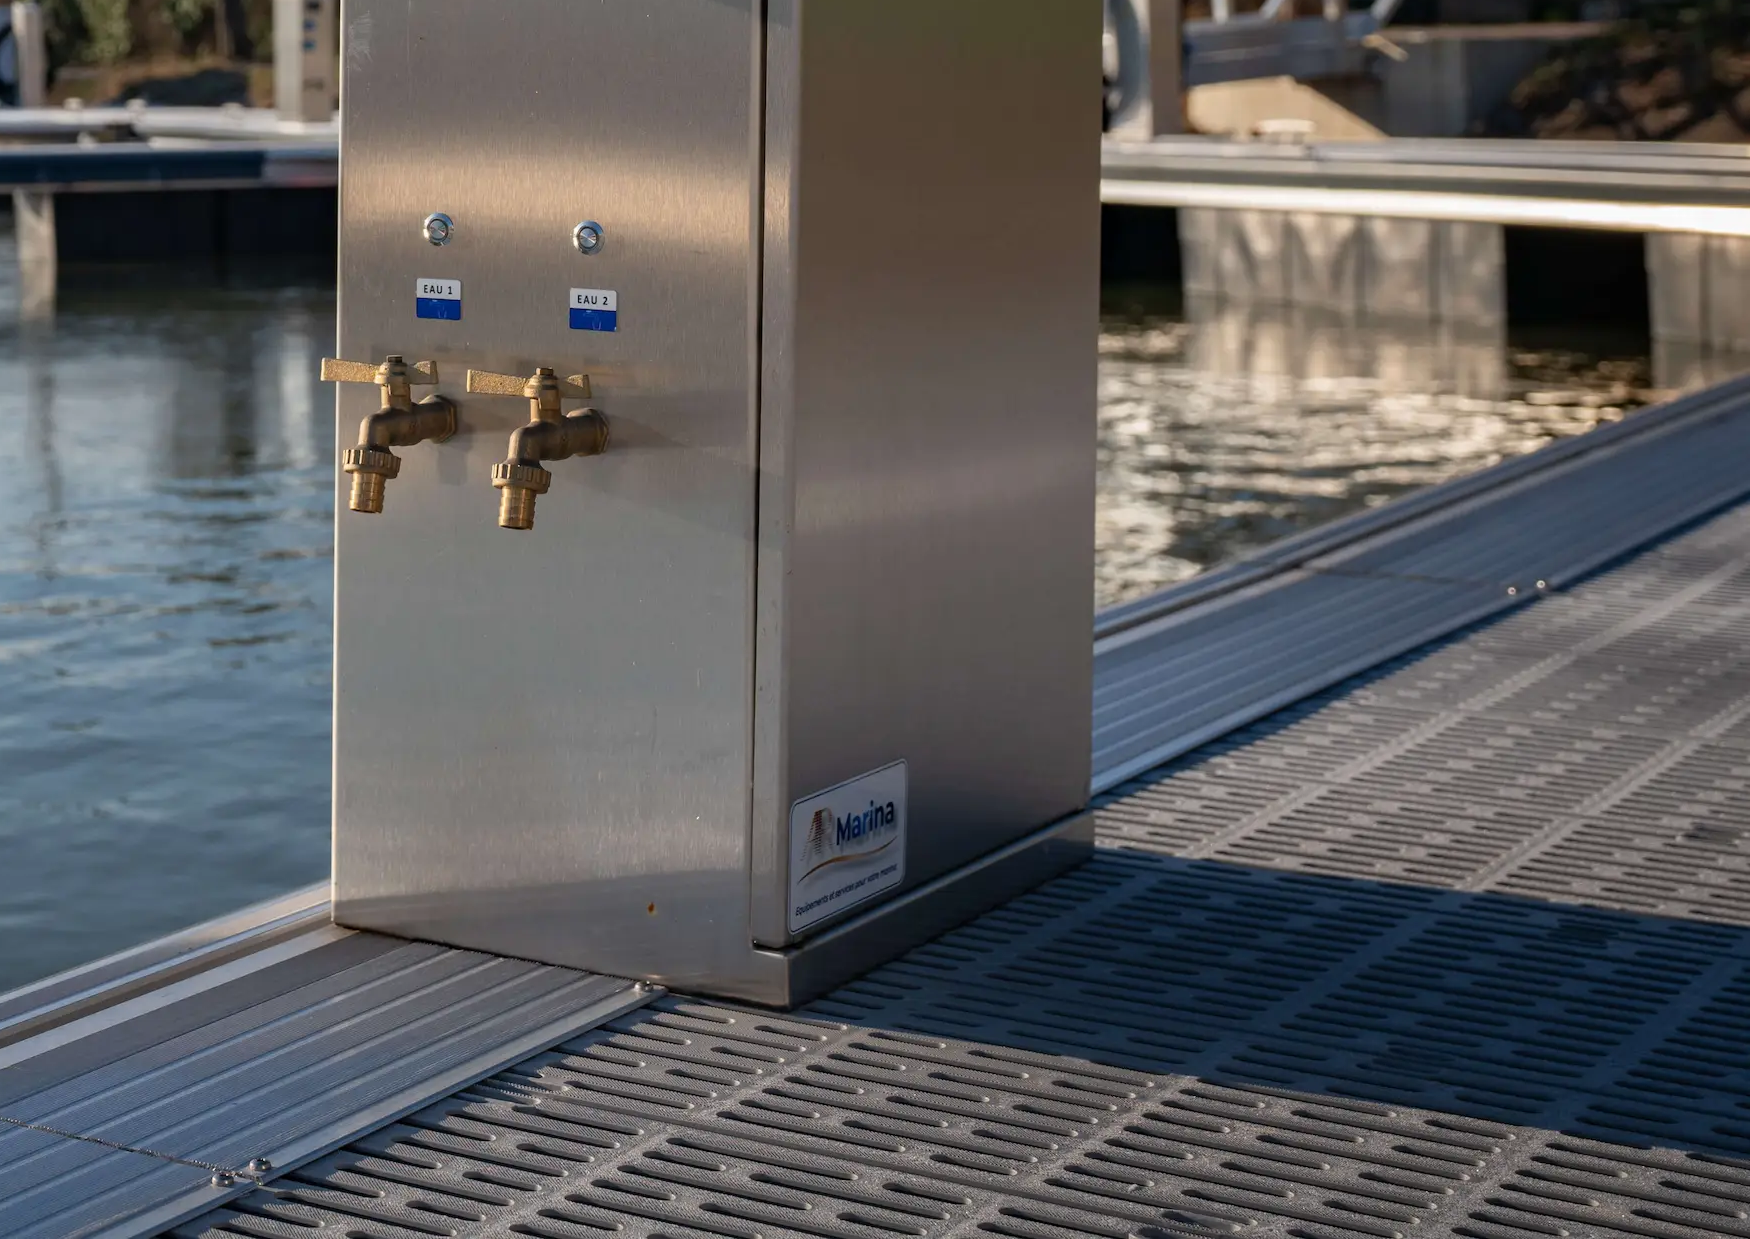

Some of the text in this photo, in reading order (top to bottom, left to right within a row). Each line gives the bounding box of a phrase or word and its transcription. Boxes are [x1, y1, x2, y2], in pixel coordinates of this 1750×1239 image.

[423, 284, 453, 295] EAU 1
[577, 294, 609, 306] EAU 2
[836, 800, 895, 846] Marina
